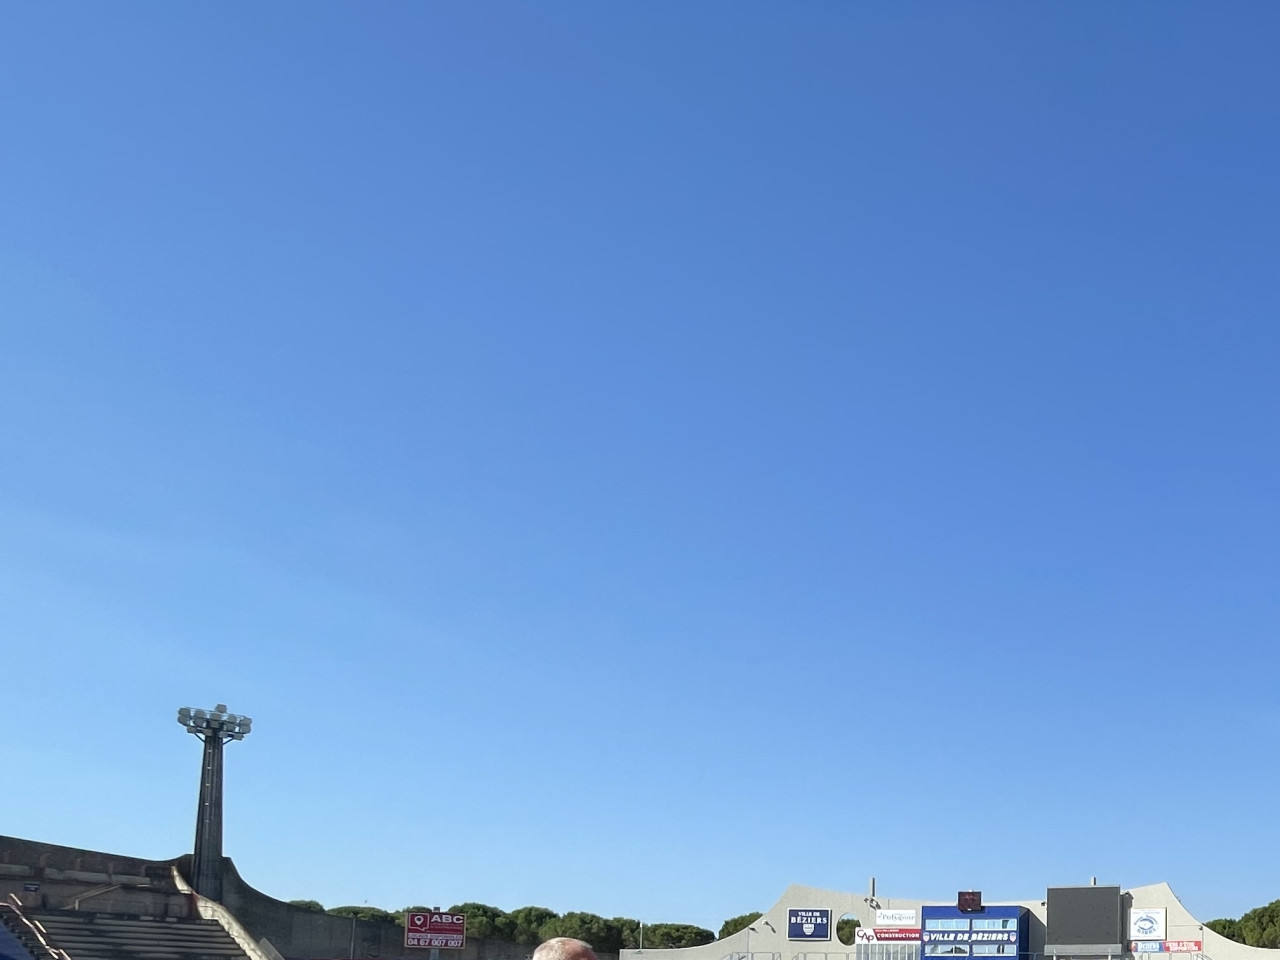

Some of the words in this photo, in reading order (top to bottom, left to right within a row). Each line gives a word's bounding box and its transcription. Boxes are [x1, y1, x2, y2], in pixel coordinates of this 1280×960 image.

[431, 914, 464, 924] ABC
[790, 916, 828, 924] BÉZIERS
[930, 933, 955, 941] VILLE
[956, 933, 969, 941] DE
[973, 931, 1009, 941] BÉZIERS
[447, 939, 462, 947] 007
